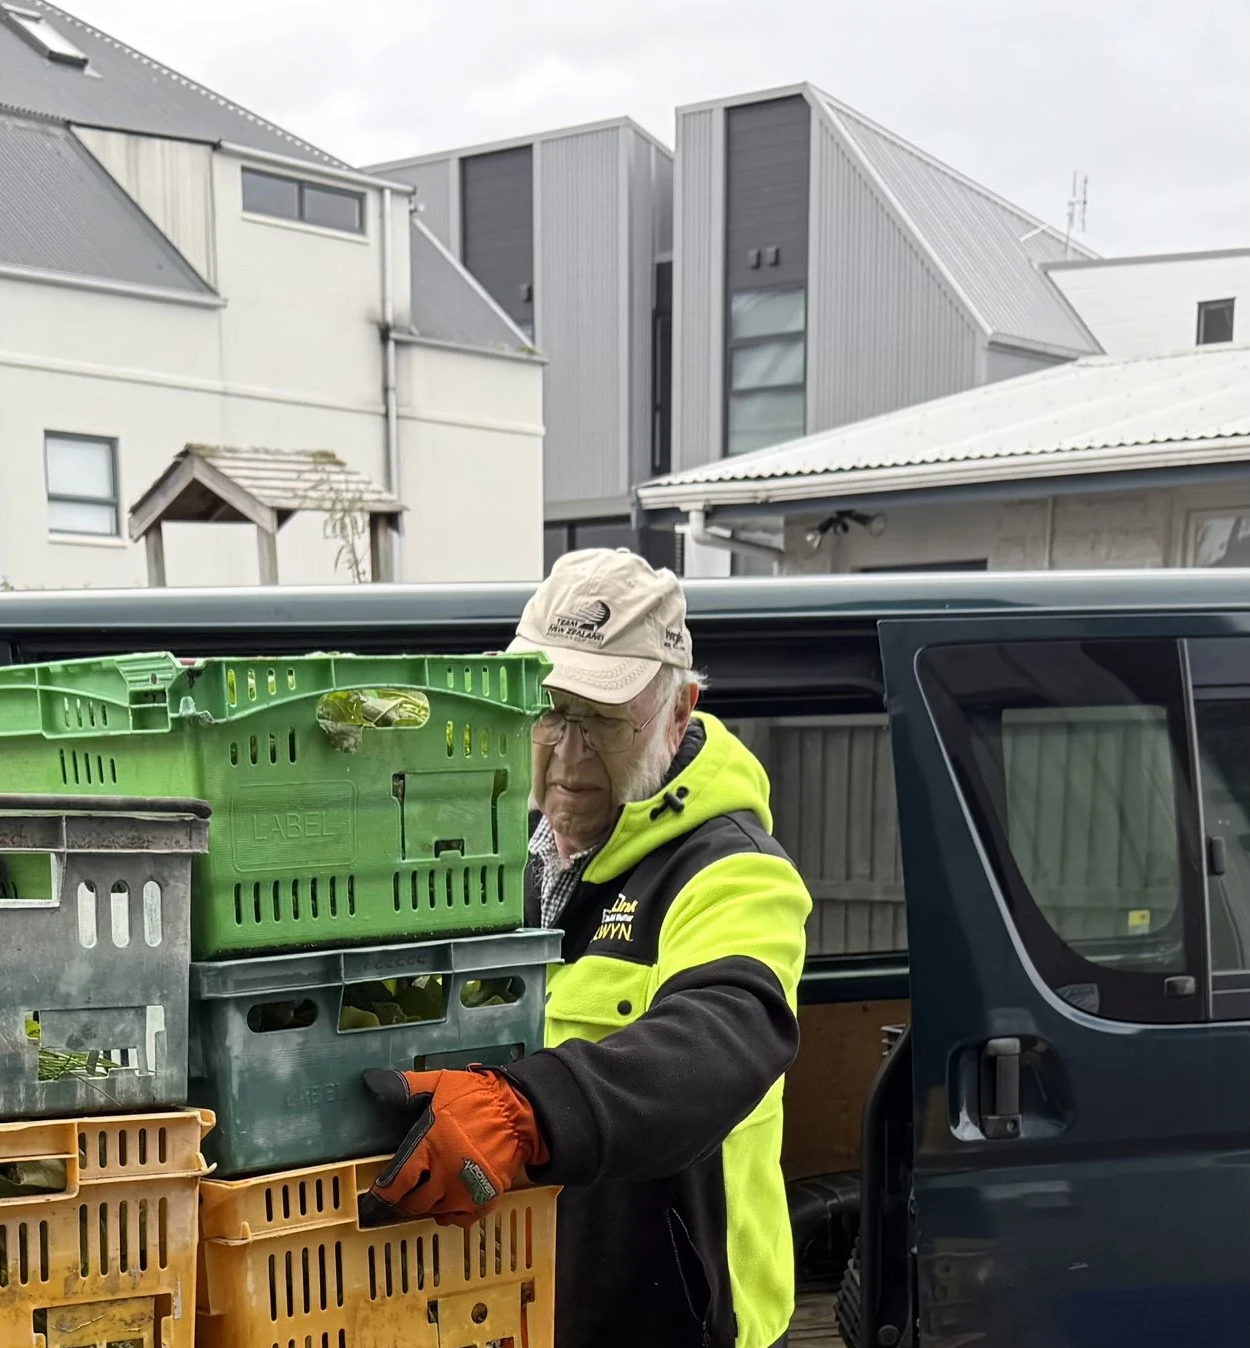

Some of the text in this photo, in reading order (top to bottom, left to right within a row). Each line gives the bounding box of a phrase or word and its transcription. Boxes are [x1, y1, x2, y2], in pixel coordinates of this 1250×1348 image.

[556, 617, 578, 628] TEAM
[566, 627, 605, 641] ZEALAND
[253, 811, 335, 840] LABEL
